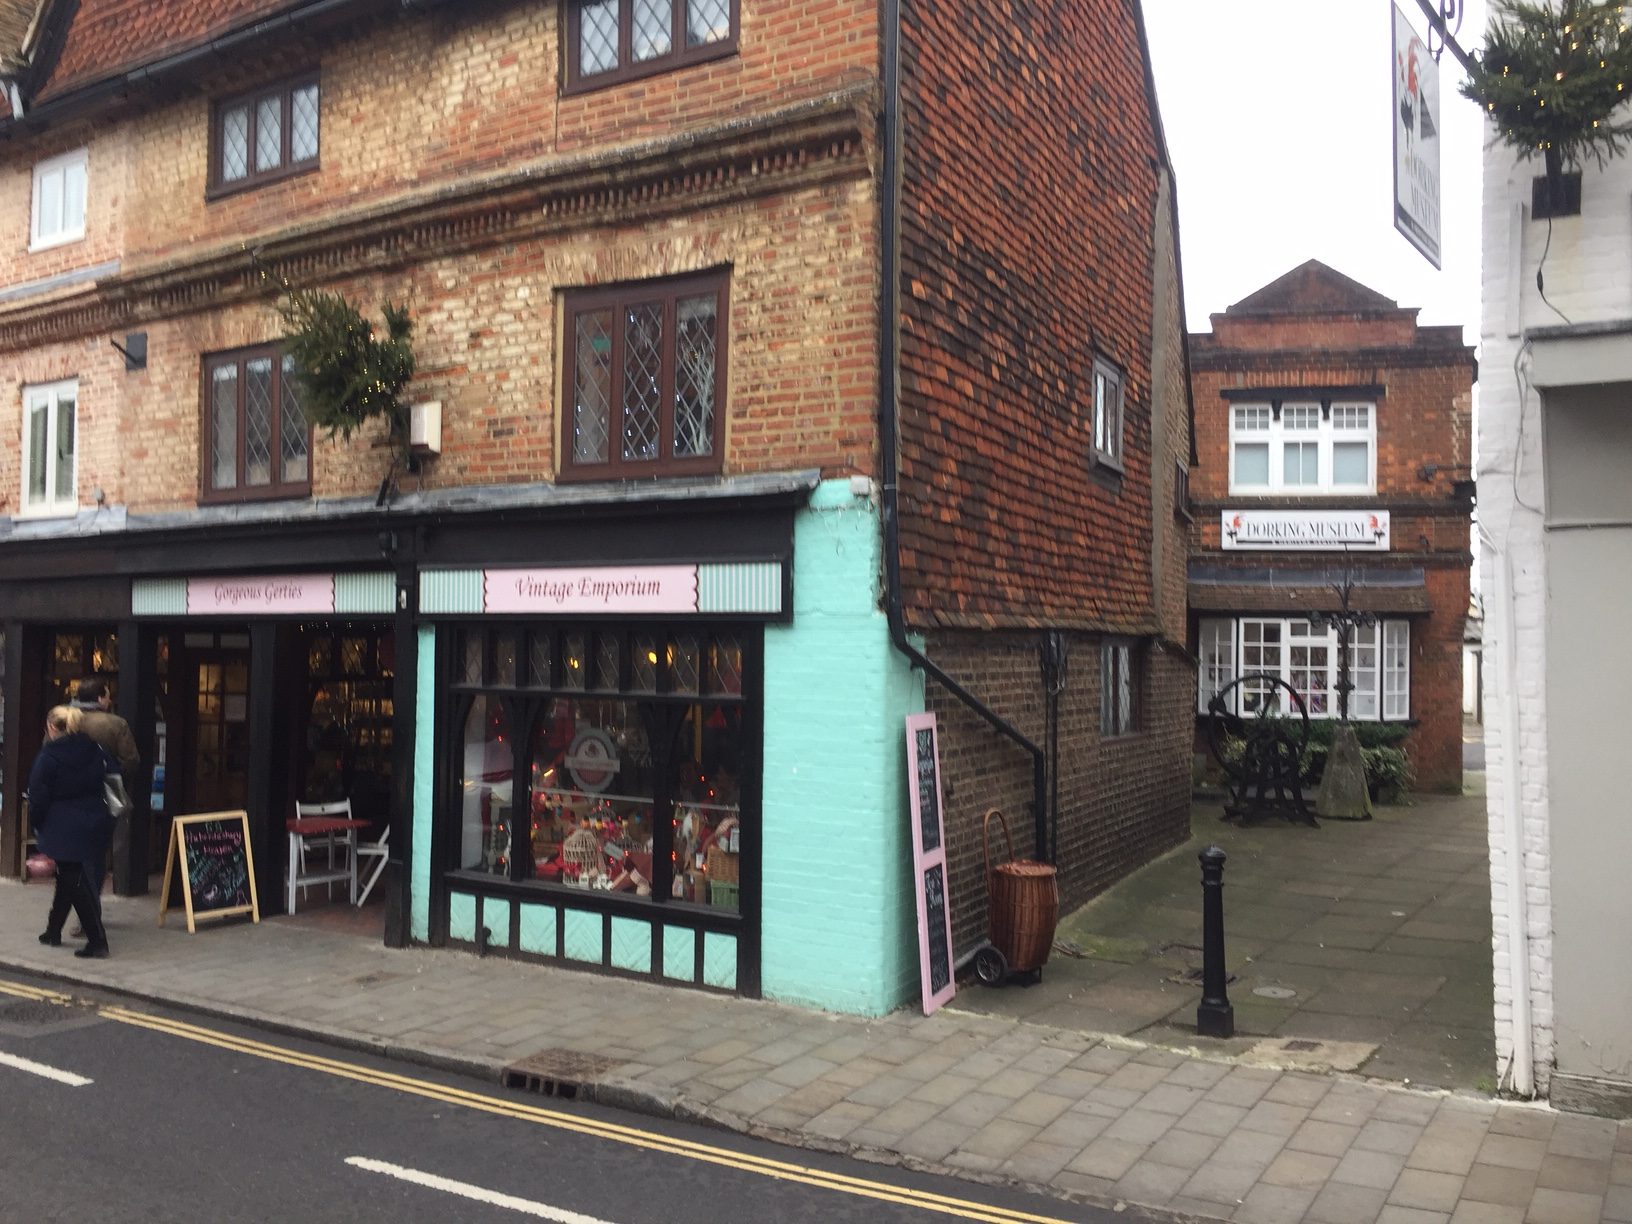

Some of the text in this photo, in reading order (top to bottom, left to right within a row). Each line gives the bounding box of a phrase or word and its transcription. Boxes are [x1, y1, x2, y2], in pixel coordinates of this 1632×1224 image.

[1246, 520, 1365, 538] DORKING MUSEUM
[214, 579, 302, 606] Gorgeous Gerties
[515, 574, 661, 603] Vintage Emporium
